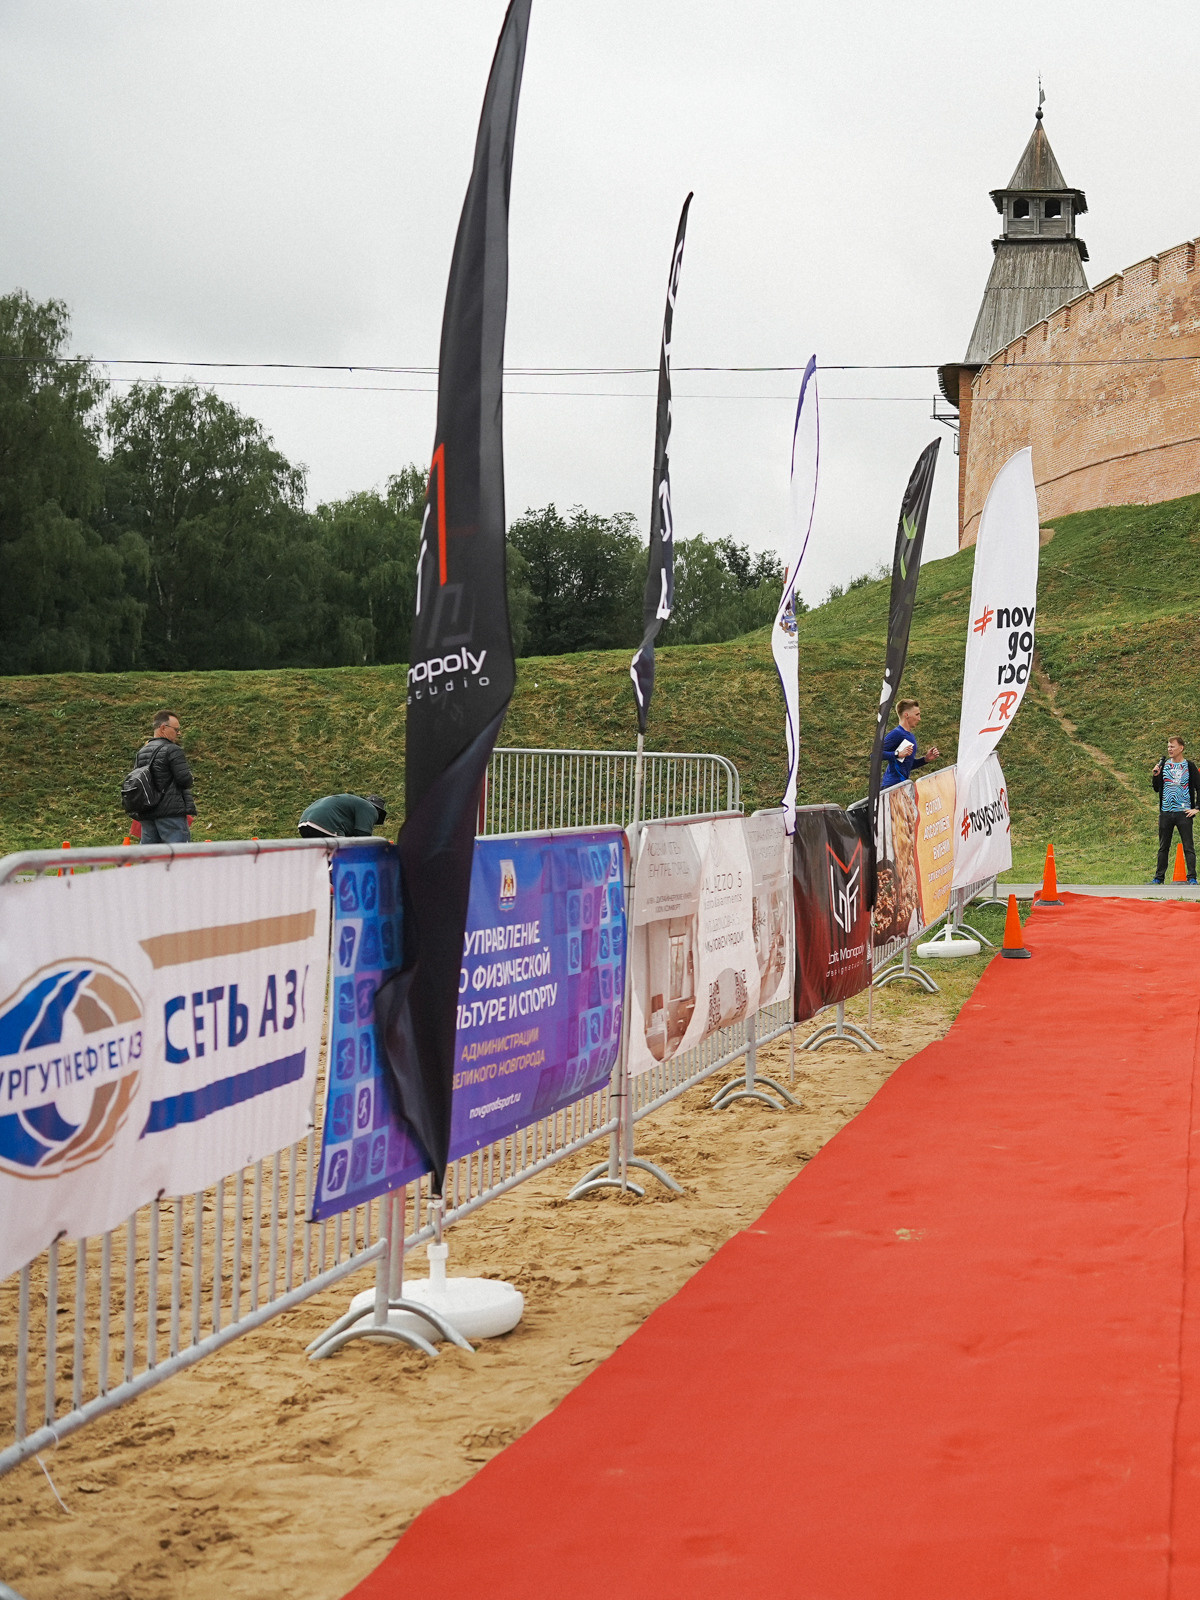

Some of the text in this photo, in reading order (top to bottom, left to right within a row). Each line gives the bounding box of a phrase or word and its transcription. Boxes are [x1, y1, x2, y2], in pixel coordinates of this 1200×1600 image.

[1008, 631, 1033, 661] go
[463, 920, 541, 957] УПРАВЛЕНИЕ
[472, 946, 551, 992] ФИЗИЧЕСКОЙ
[163, 964, 310, 1065] СЕТЬ АЗ
[508, 995, 518, 1020] И
[518, 982, 558, 1016] СПОРТУ
[461, 1026, 540, 1062] АДМИНИСТРАЦИИ
[498, 1048, 546, 1077] НОВГОРОДА
